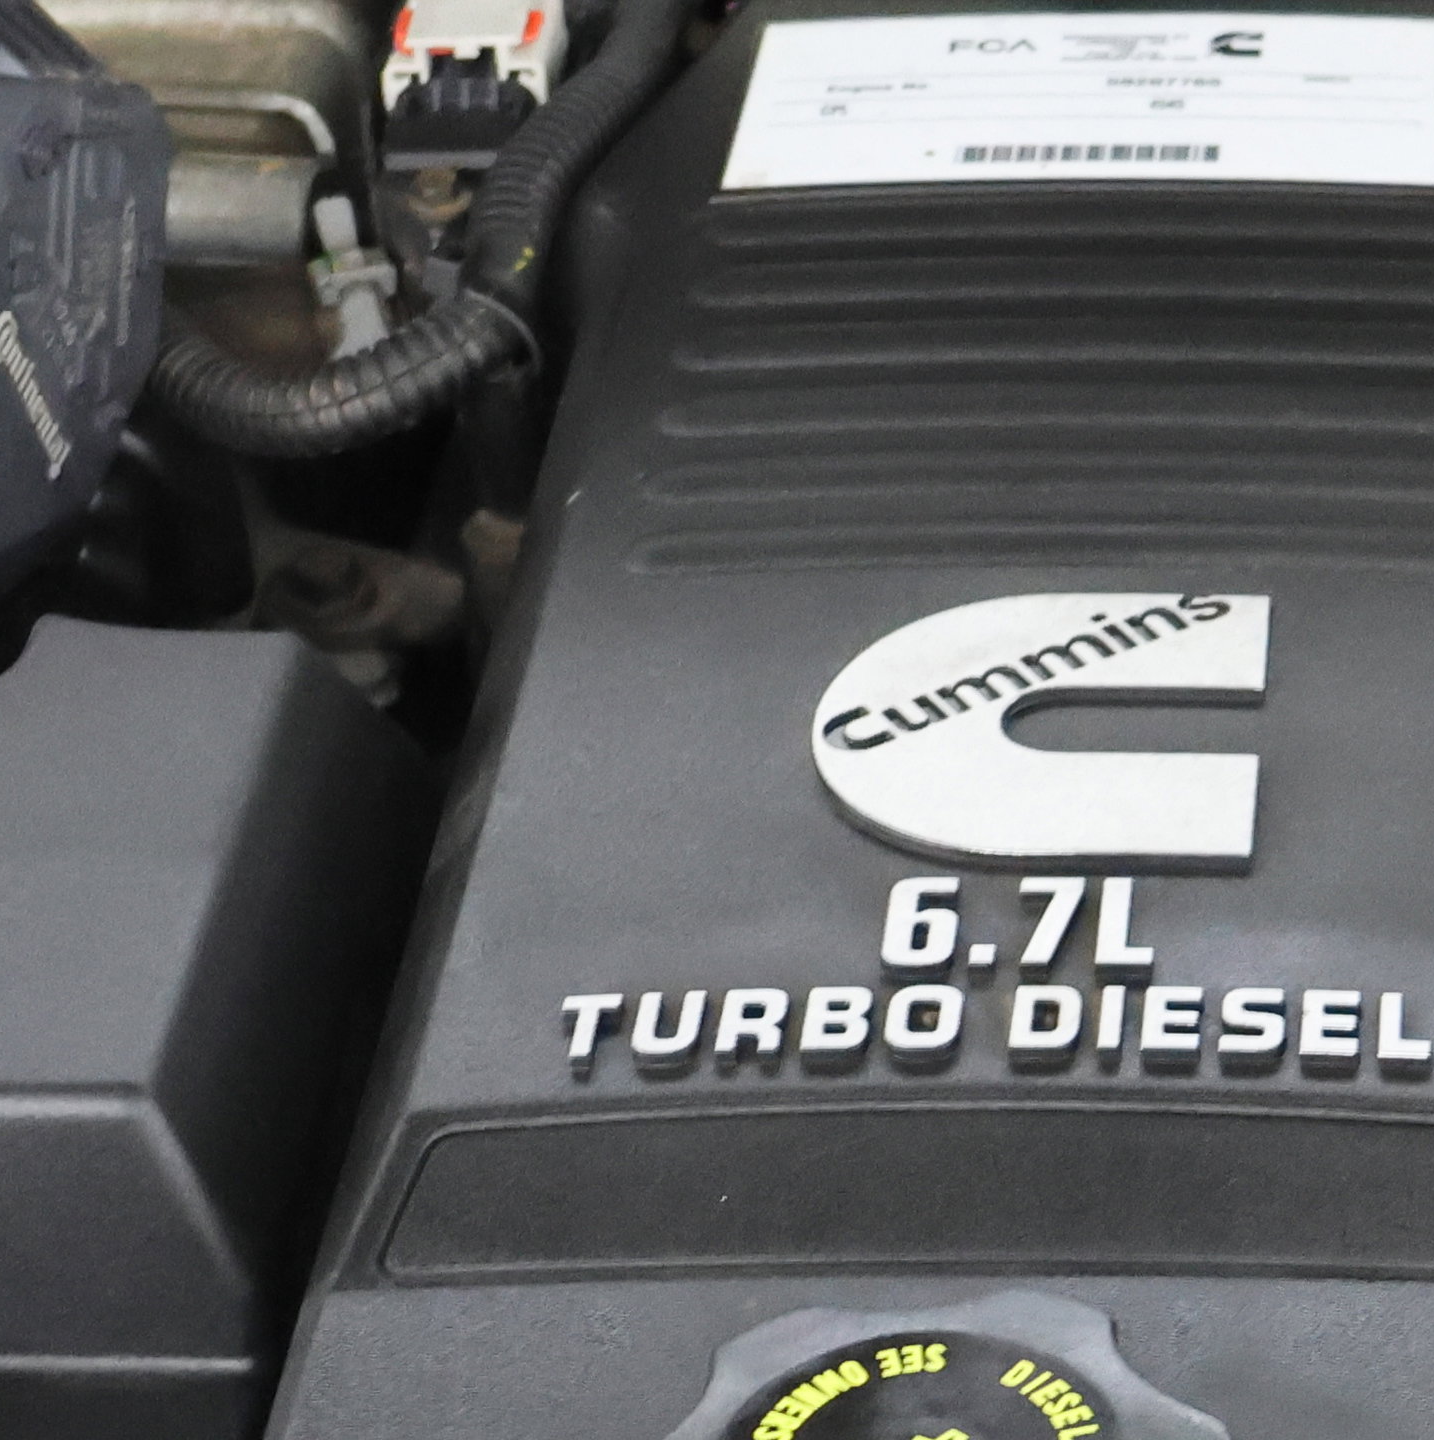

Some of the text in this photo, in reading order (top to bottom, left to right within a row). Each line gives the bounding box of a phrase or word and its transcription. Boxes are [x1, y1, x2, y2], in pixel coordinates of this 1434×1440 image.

[948, 37, 1038, 55] FCA
[822, 593, 1233, 751] Cummins
[879, 875, 1156, 970] 6.7L
[561, 984, 965, 1062] TURBO
[875, 1342, 949, 1380] SEE
